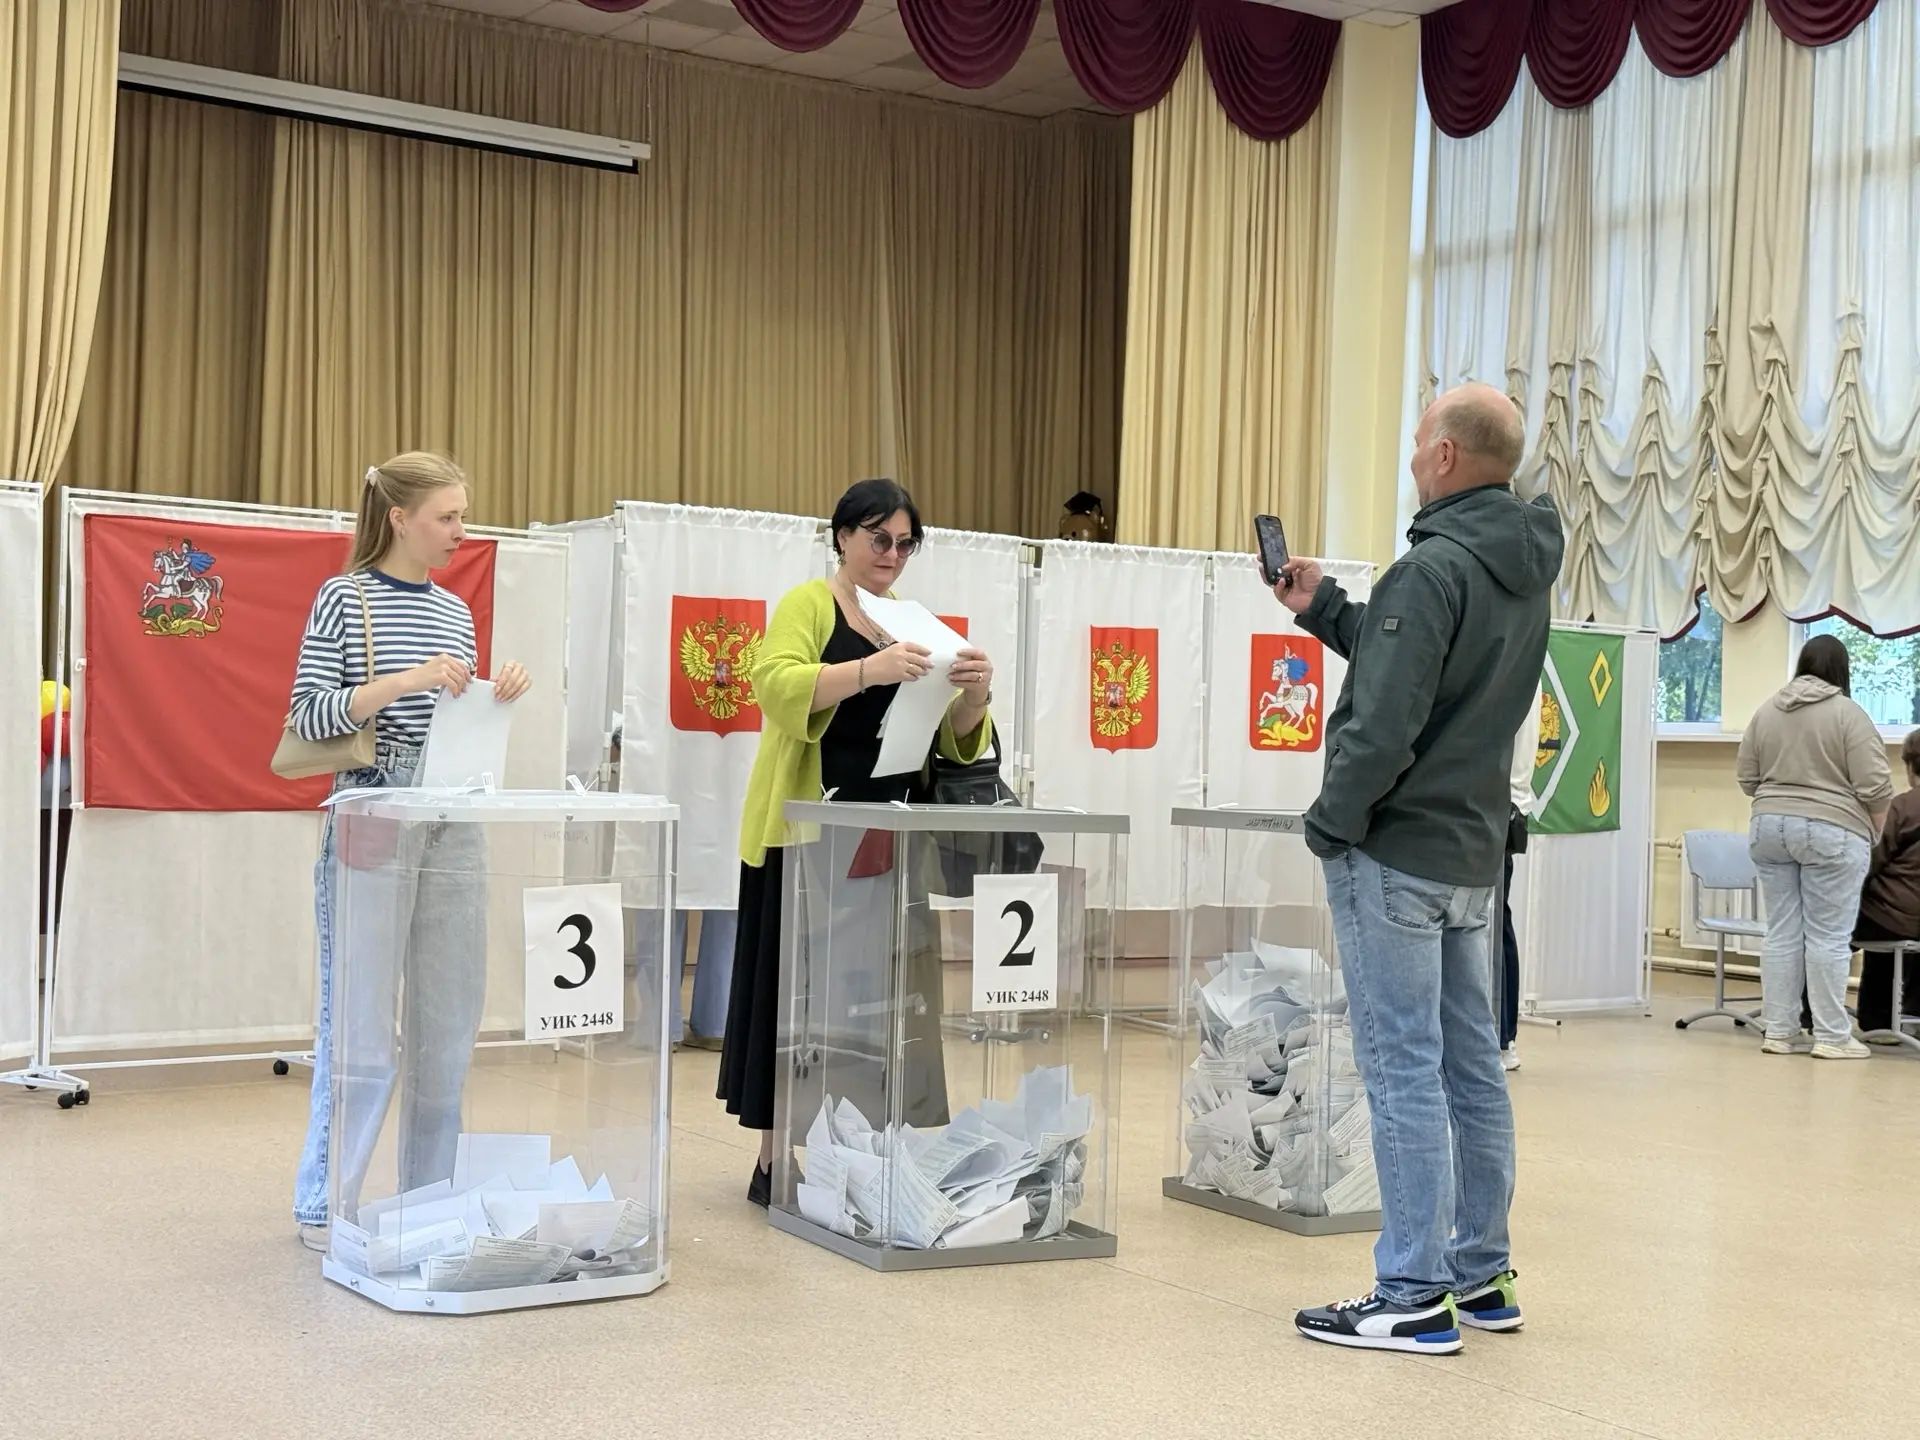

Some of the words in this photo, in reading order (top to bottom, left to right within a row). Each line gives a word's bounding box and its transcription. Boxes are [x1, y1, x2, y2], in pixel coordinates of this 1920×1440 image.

[554, 914, 596, 989] 3
[998, 899, 1036, 967] 2
[986, 991, 1018, 1004] УИК
[1021, 990, 1049, 1003] 2448
[540, 1014, 577, 1030] УИК
[582, 1011, 614, 1027] 2448
